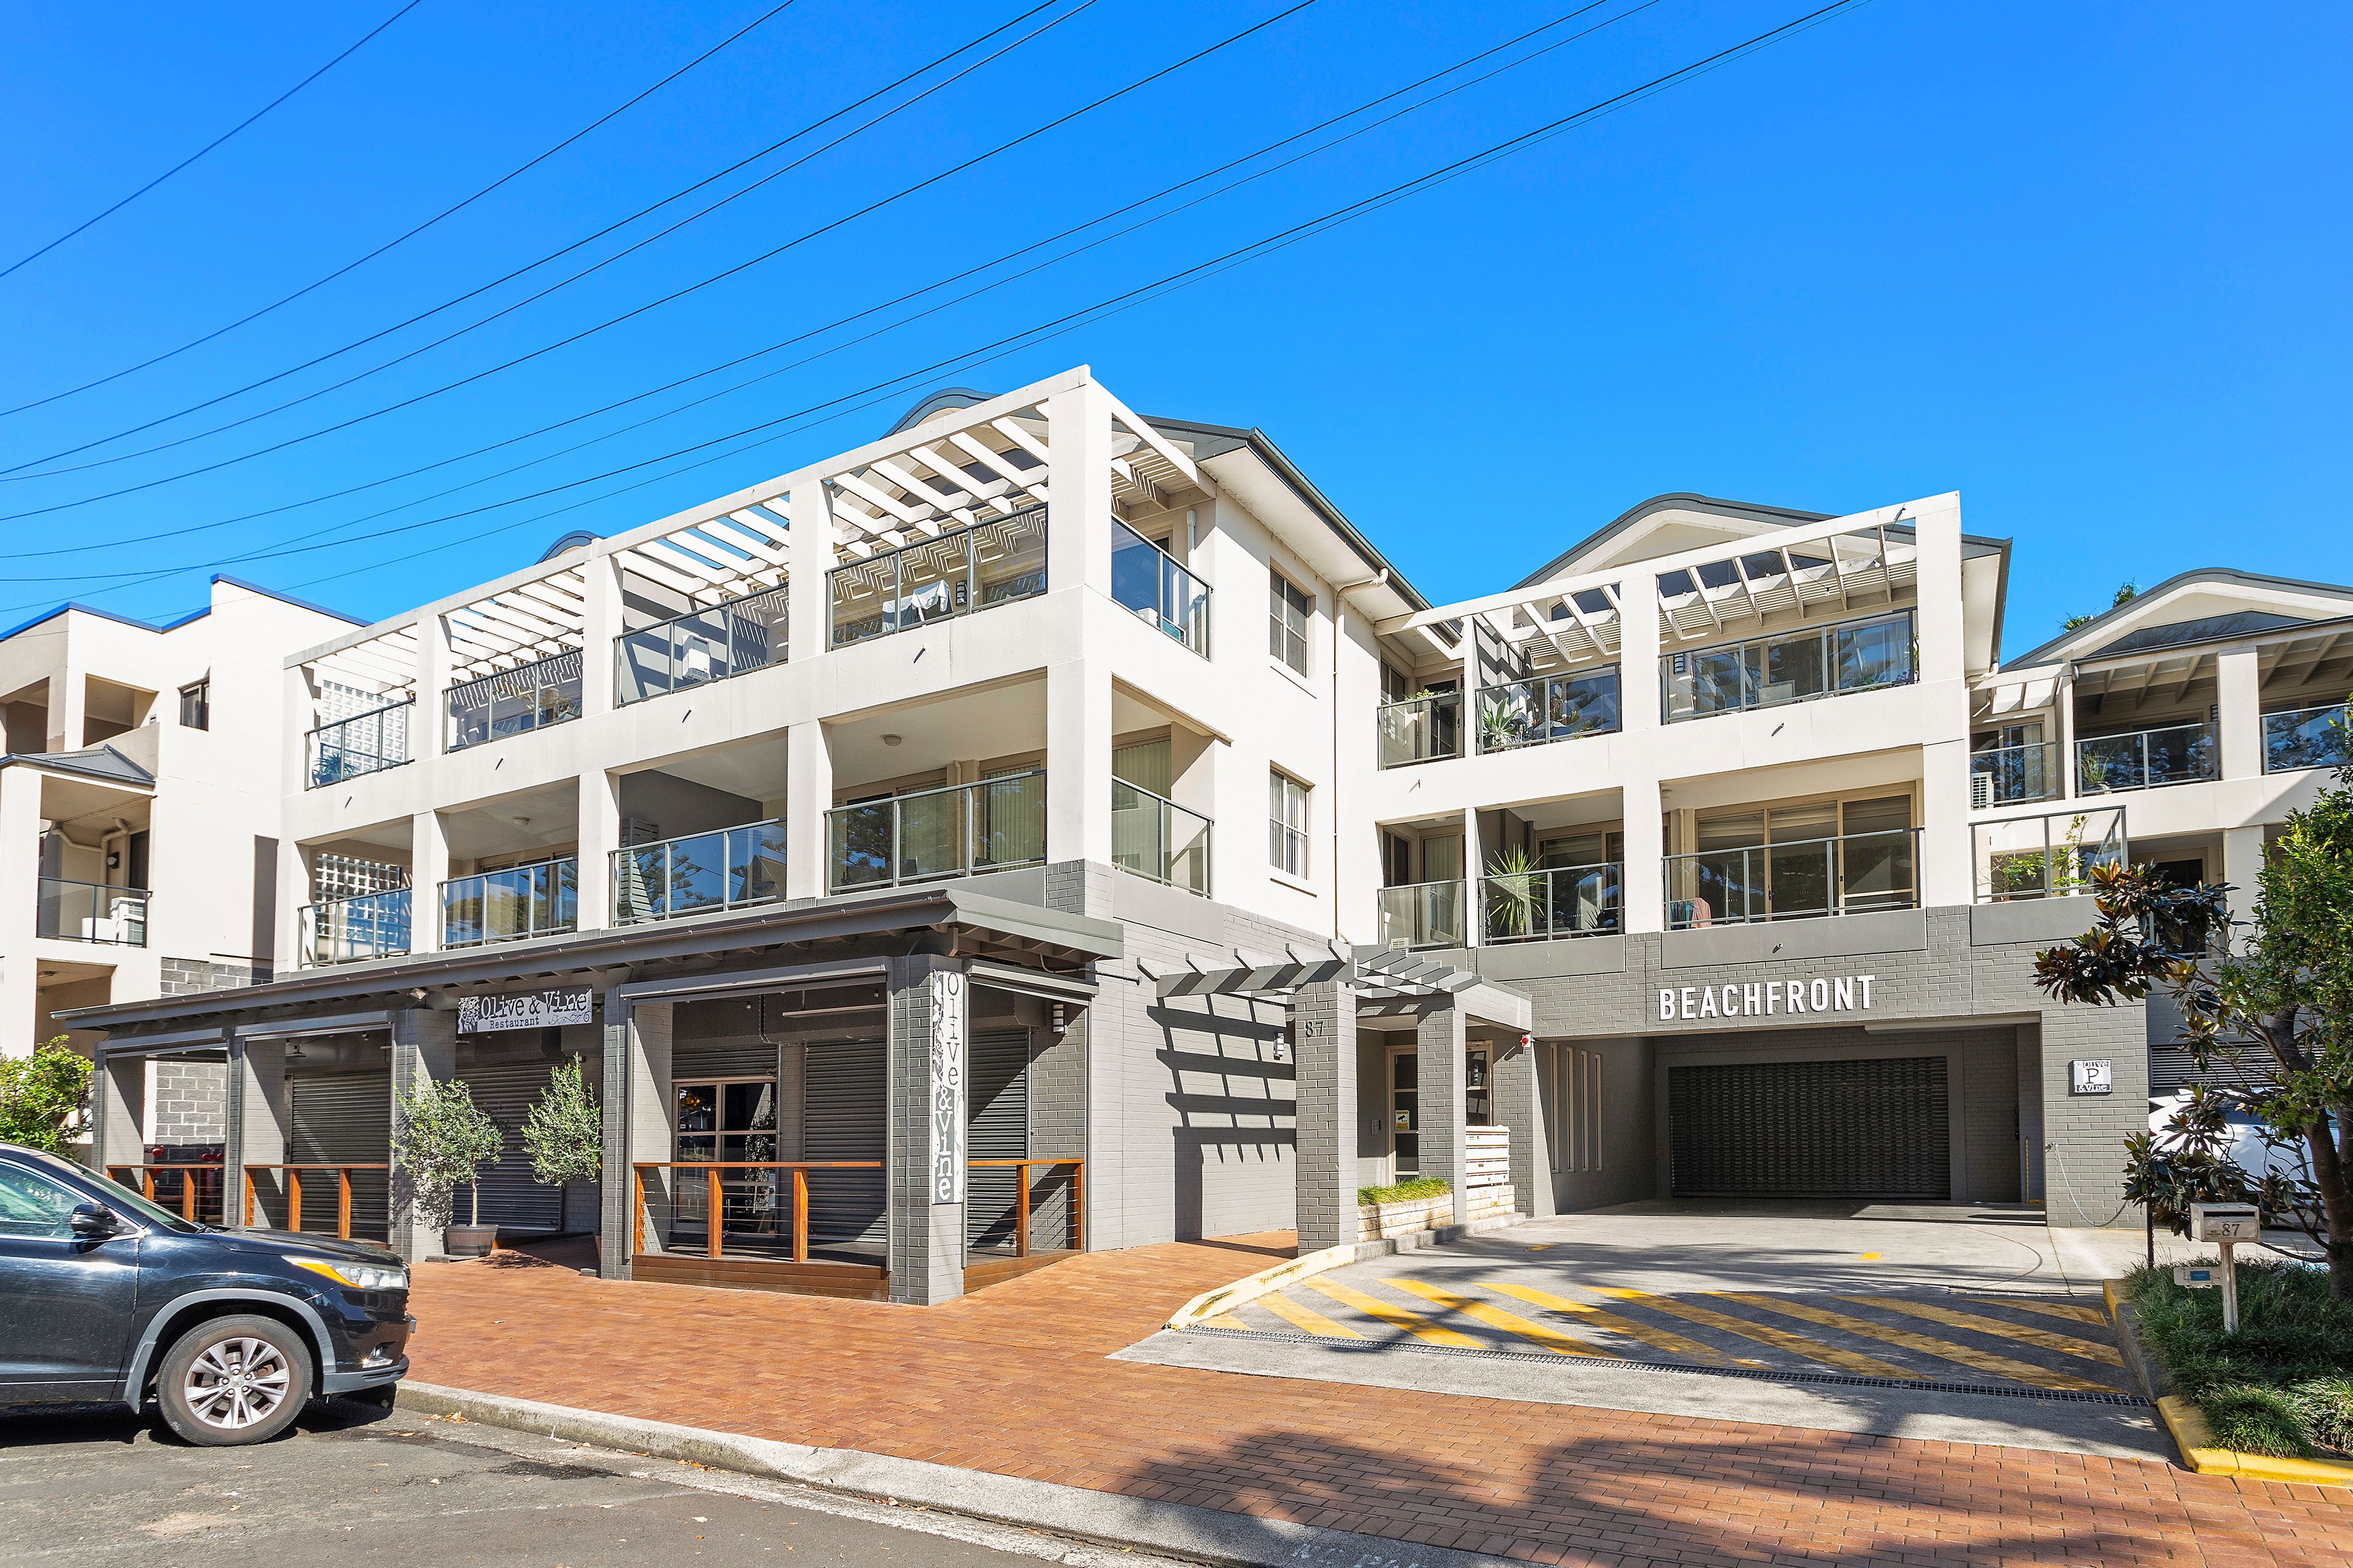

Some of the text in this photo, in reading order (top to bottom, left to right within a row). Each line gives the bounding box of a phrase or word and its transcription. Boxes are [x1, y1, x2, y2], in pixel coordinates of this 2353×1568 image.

[481, 990, 587, 1019] Olive & Vine
[1659, 975, 1875, 1021] BEACHFRONT
[490, 1015, 540, 1029] Restaurant
[1305, 1020, 1324, 1037] 87
[2086, 1068, 2099, 1084] P
[935, 973, 959, 1200] Olive & Vine
[2222, 1223, 2240, 1236] 87
